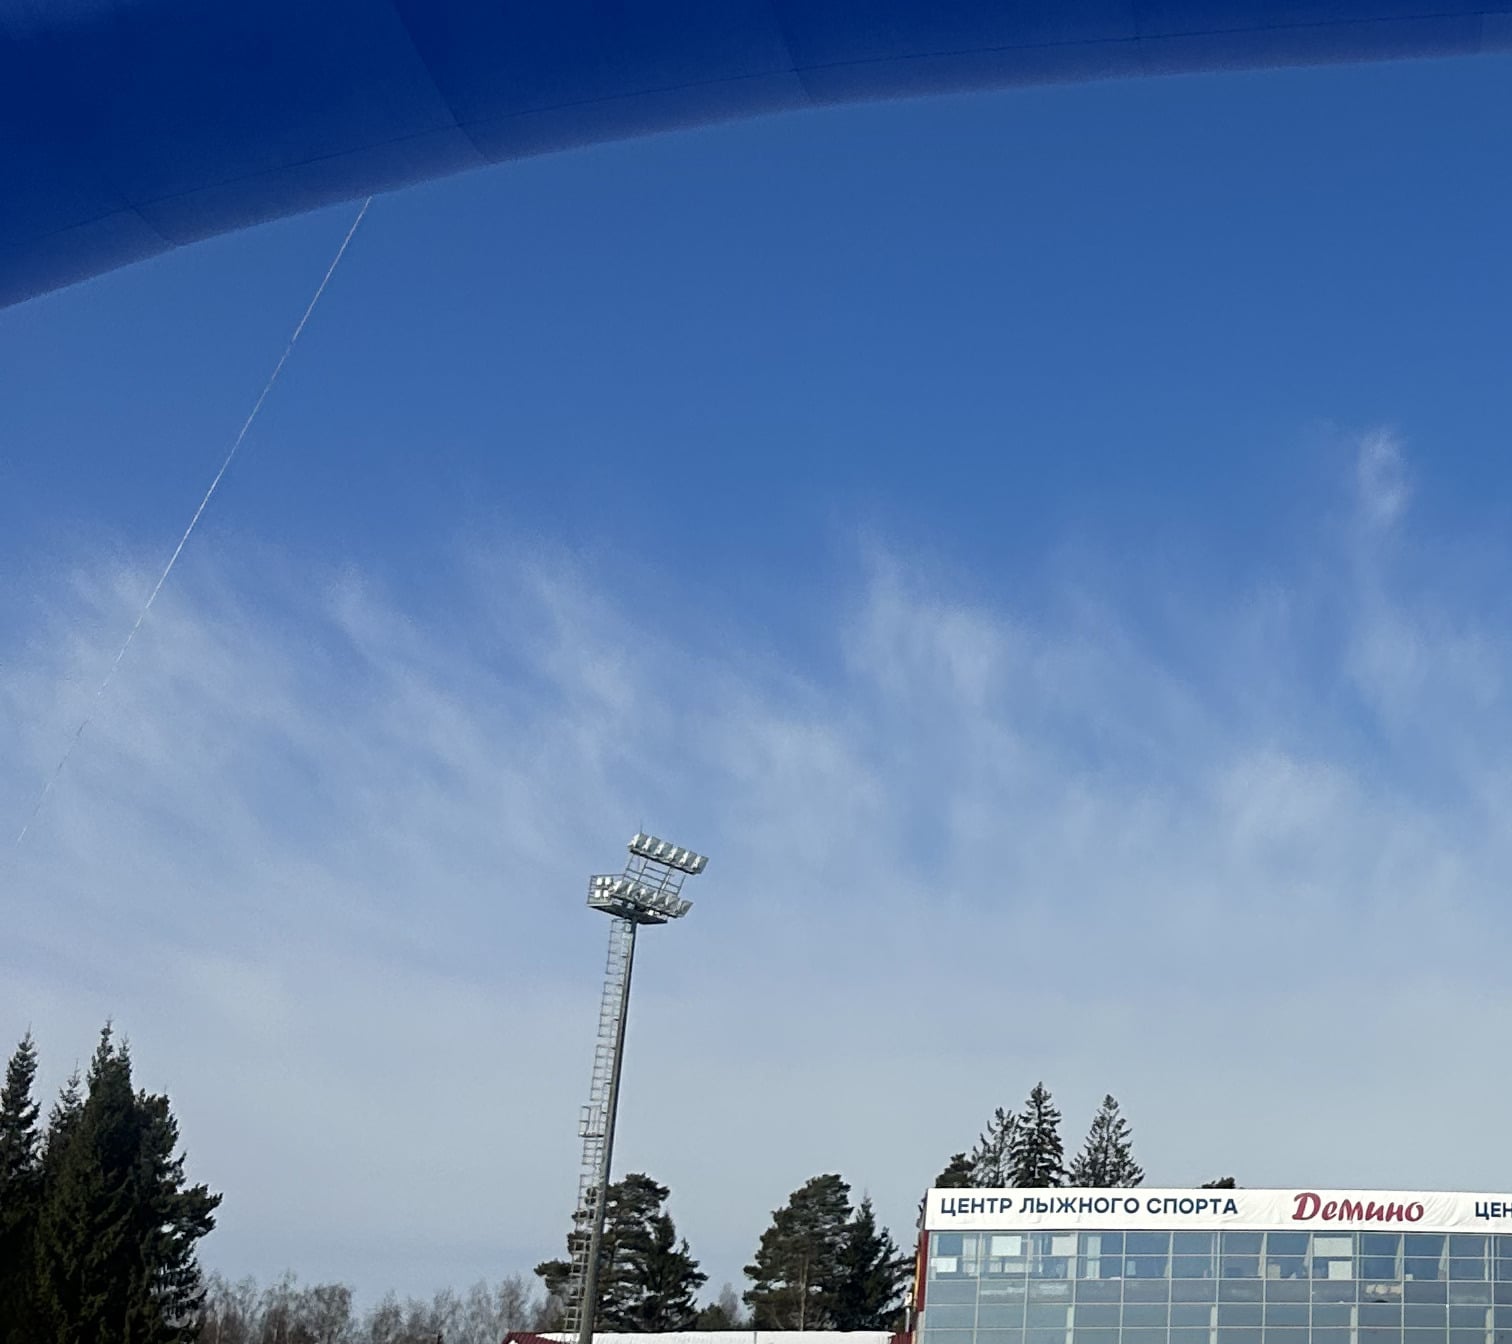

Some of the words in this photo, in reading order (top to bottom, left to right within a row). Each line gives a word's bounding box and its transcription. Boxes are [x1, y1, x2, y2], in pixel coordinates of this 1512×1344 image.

[940, 1197, 1013, 1216] ЦЕНТР
[1019, 1197, 1140, 1214] ЛЫЖНОГО
[1146, 1197, 1239, 1215] СПОРТА
[1292, 1191, 1425, 1223] Демино
